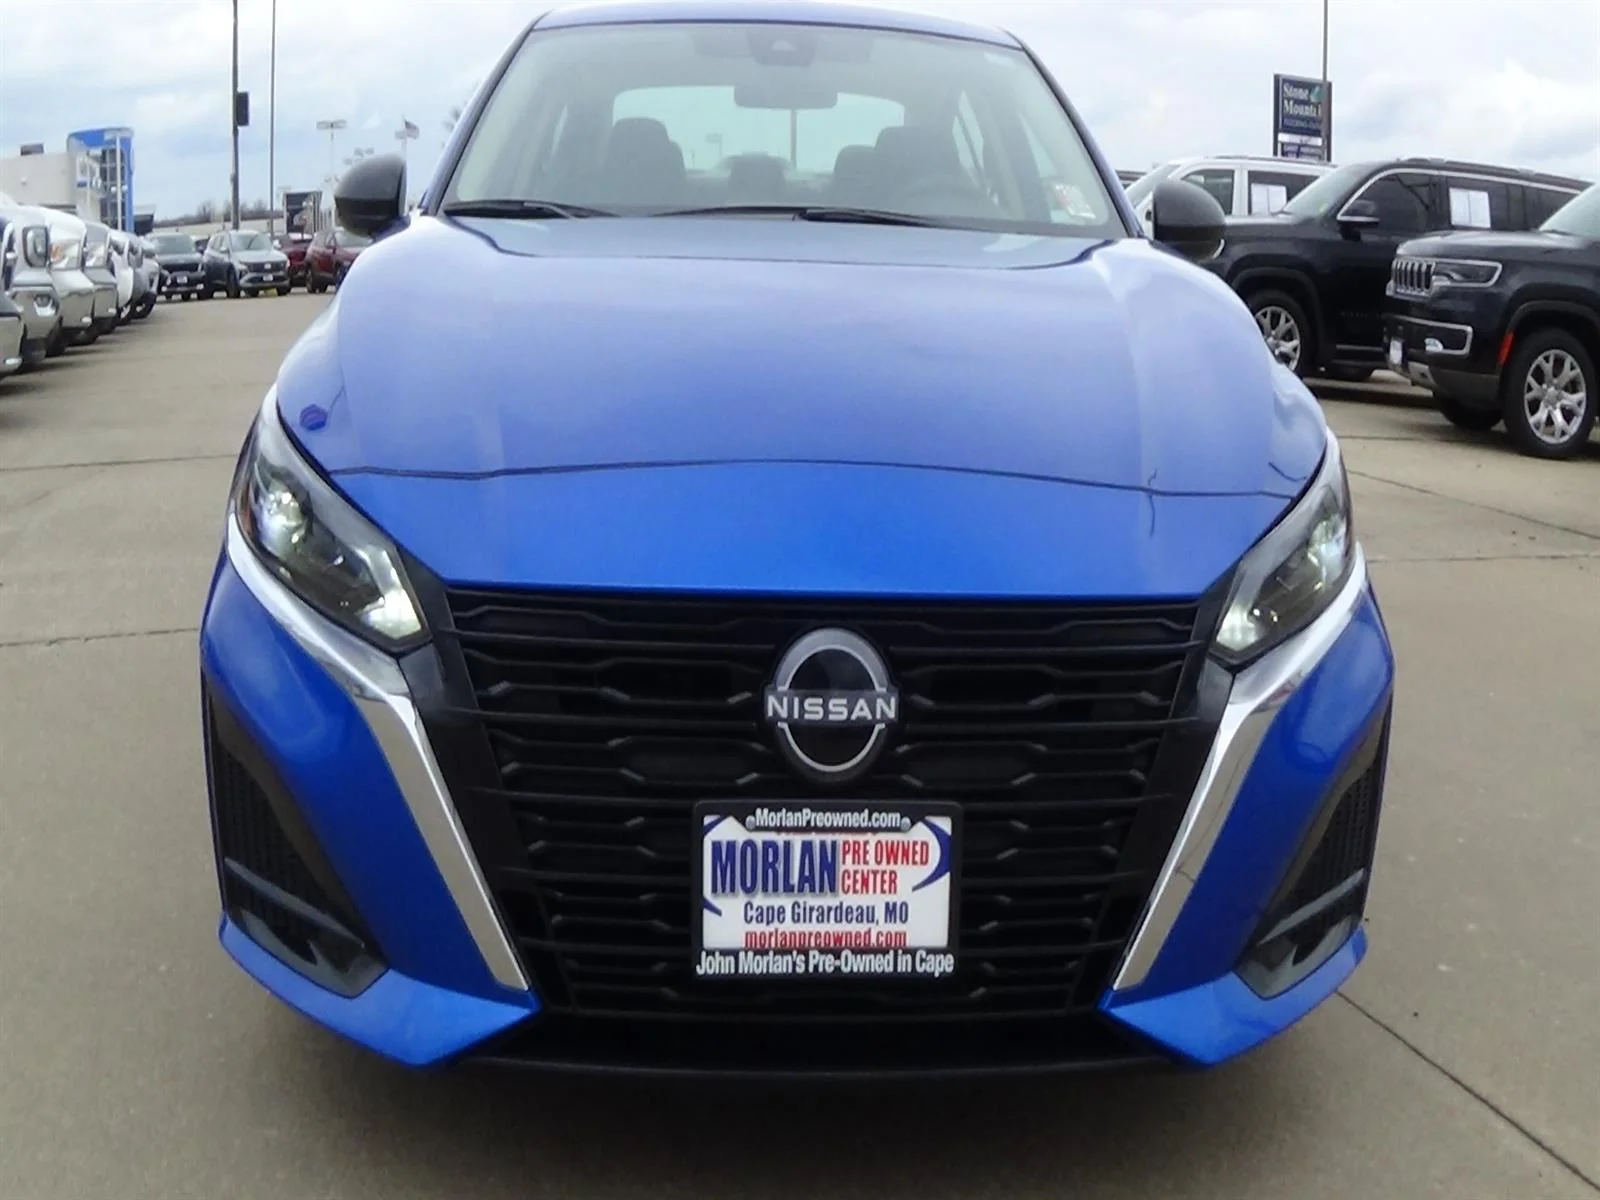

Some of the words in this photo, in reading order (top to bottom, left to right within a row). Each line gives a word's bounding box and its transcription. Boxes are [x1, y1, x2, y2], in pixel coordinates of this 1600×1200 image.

[767, 695, 896, 721] NISSAN
[755, 808, 901, 829] MorlanPreowned.com
[842, 840, 869, 865] PRE
[875, 840, 929, 866] OWNED
[711, 839, 838, 895] MORLAN
[841, 869, 897, 895] CENTER
[744, 901, 786, 926] Cape
[791, 901, 880, 926] Girardeau,
[884, 901, 909, 925] MO
[744, 928, 907, 948] morlanpreowned.com
[696, 951, 735, 975] John
[738, 950, 805, 974] Morlan's
[809, 949, 893, 974] Pre-Owned
[897, 950, 912, 973] in
[915, 951, 954, 977] Cape
